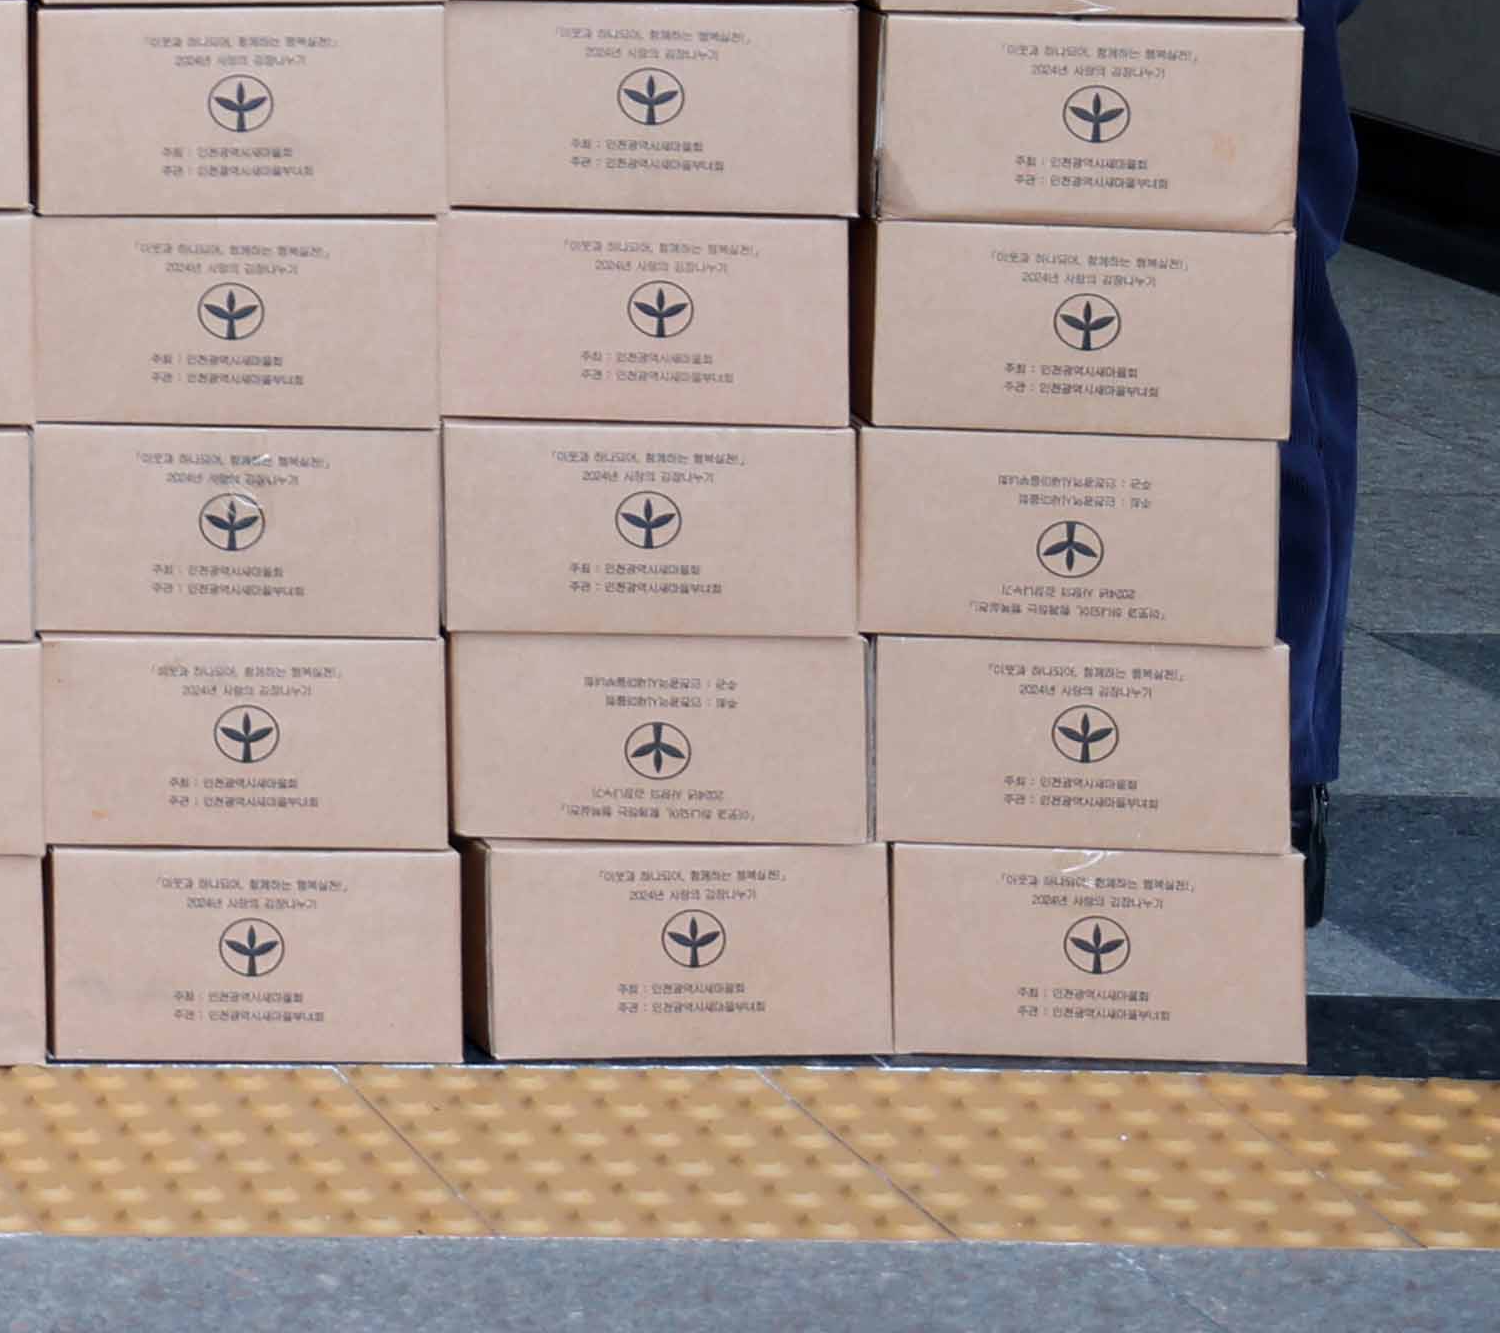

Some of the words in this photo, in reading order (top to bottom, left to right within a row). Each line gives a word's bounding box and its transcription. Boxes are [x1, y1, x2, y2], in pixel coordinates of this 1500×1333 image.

[1082, 666, 1127, 680] 함께하는
[1018, 682, 1057, 695] 2024년
[1061, 683, 1094, 697] 사랑의
[1098, 685, 1153, 699] 김장나누기
[1039, 776, 1138, 791] 인천광역시새마을회
[1039, 793, 1160, 809] 인천광역시새마을부녀회
